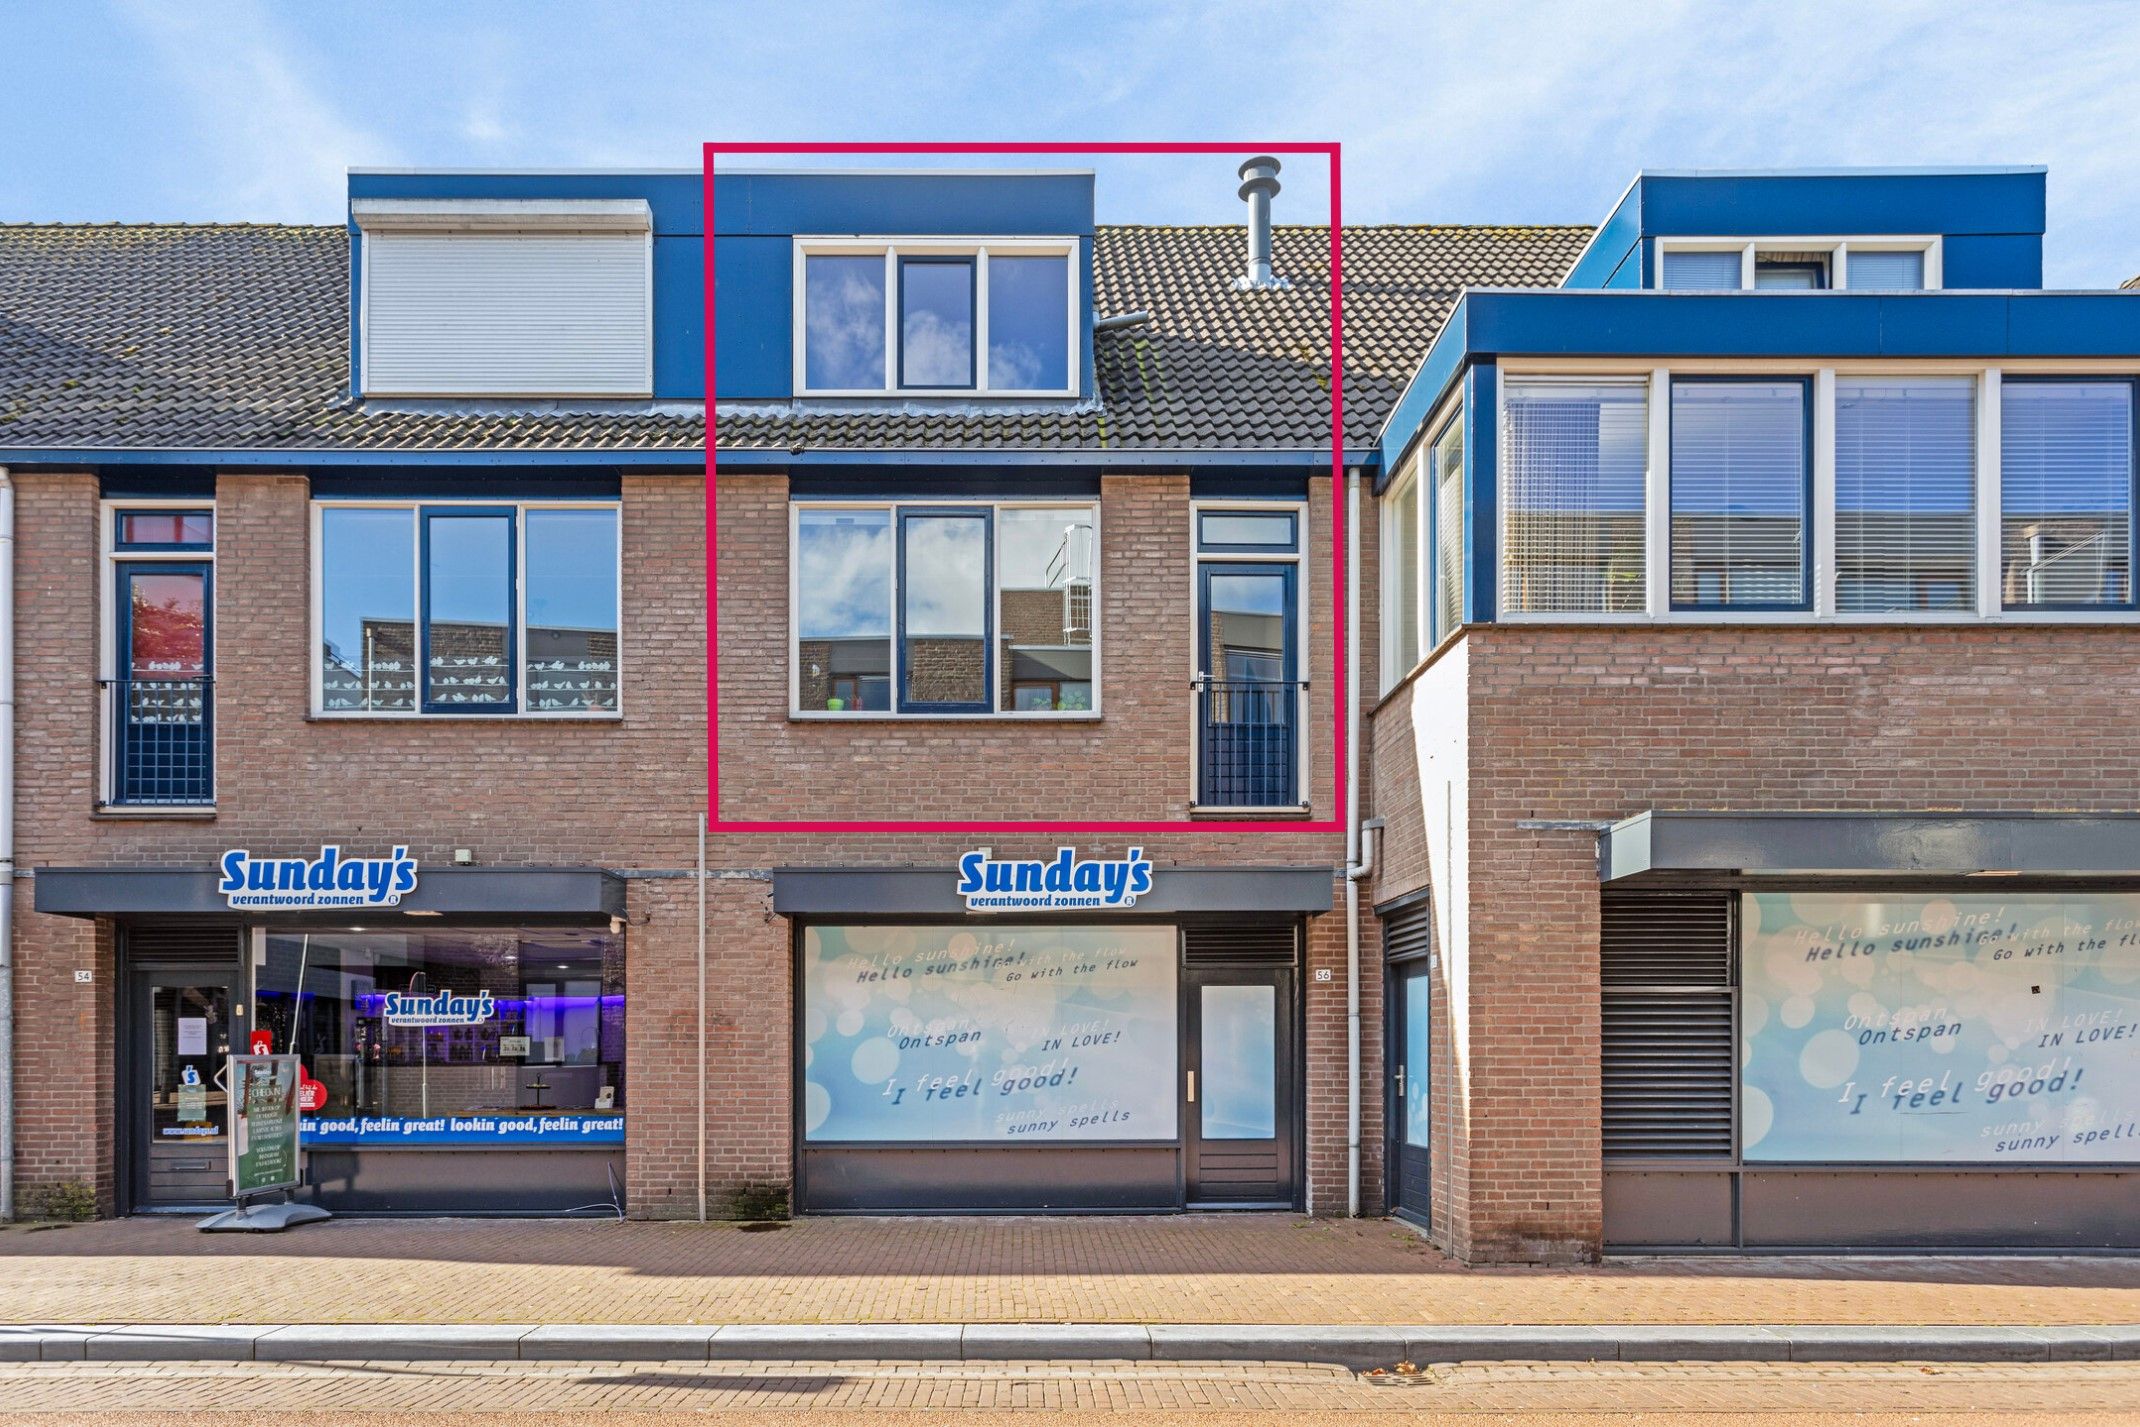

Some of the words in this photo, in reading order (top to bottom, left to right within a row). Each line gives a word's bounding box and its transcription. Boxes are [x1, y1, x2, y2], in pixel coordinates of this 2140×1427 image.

[222, 848, 415, 902] Sunday's
[960, 850, 1150, 904] Sunday's
[232, 893, 315, 905] verantwoord
[318, 896, 364, 905] zonnen
[971, 895, 1051, 907] verantwoord
[1054, 897, 1100, 906] zonnen
[1804, 939, 1876, 962] Hello
[1993, 949, 2013, 961] Go
[2024, 940, 2064, 957] with
[2078, 939, 2106, 951] the
[2120, 933, 2140, 947] fl
[857, 966, 913, 983] Hello
[1006, 972, 1022, 982] Go
[1031, 966, 1063, 979] with
[1073, 963, 1096, 974] the
[1107, 958, 1139, 970] flow
[386, 991, 493, 1022] Sunday's
[899, 1031, 981, 1050] Ontspan
[1041, 1038, 1061, 1051] IN
[1071, 1031, 1121, 1049] LOVE!
[1858, 1023, 1962, 1046] Ontspan
[2038, 1034, 2063, 1049] IN
[2076, 1024, 2138, 1044] LOVE!
[891, 1088, 906, 1105] I
[1000, 1066, 1079, 1096] good!
[1850, 1093, 1868, 1115] I
[1985, 1068, 2084, 1104] good!
[402, 1118, 446, 1135] great!
[581, 1117, 624, 1135] great!
[1007, 1119, 1059, 1135] sunny
[1069, 1110, 1131, 1128] spells
[1995, 1132, 2060, 1153] sunny
[2073, 1122, 2140, 1146] spell
